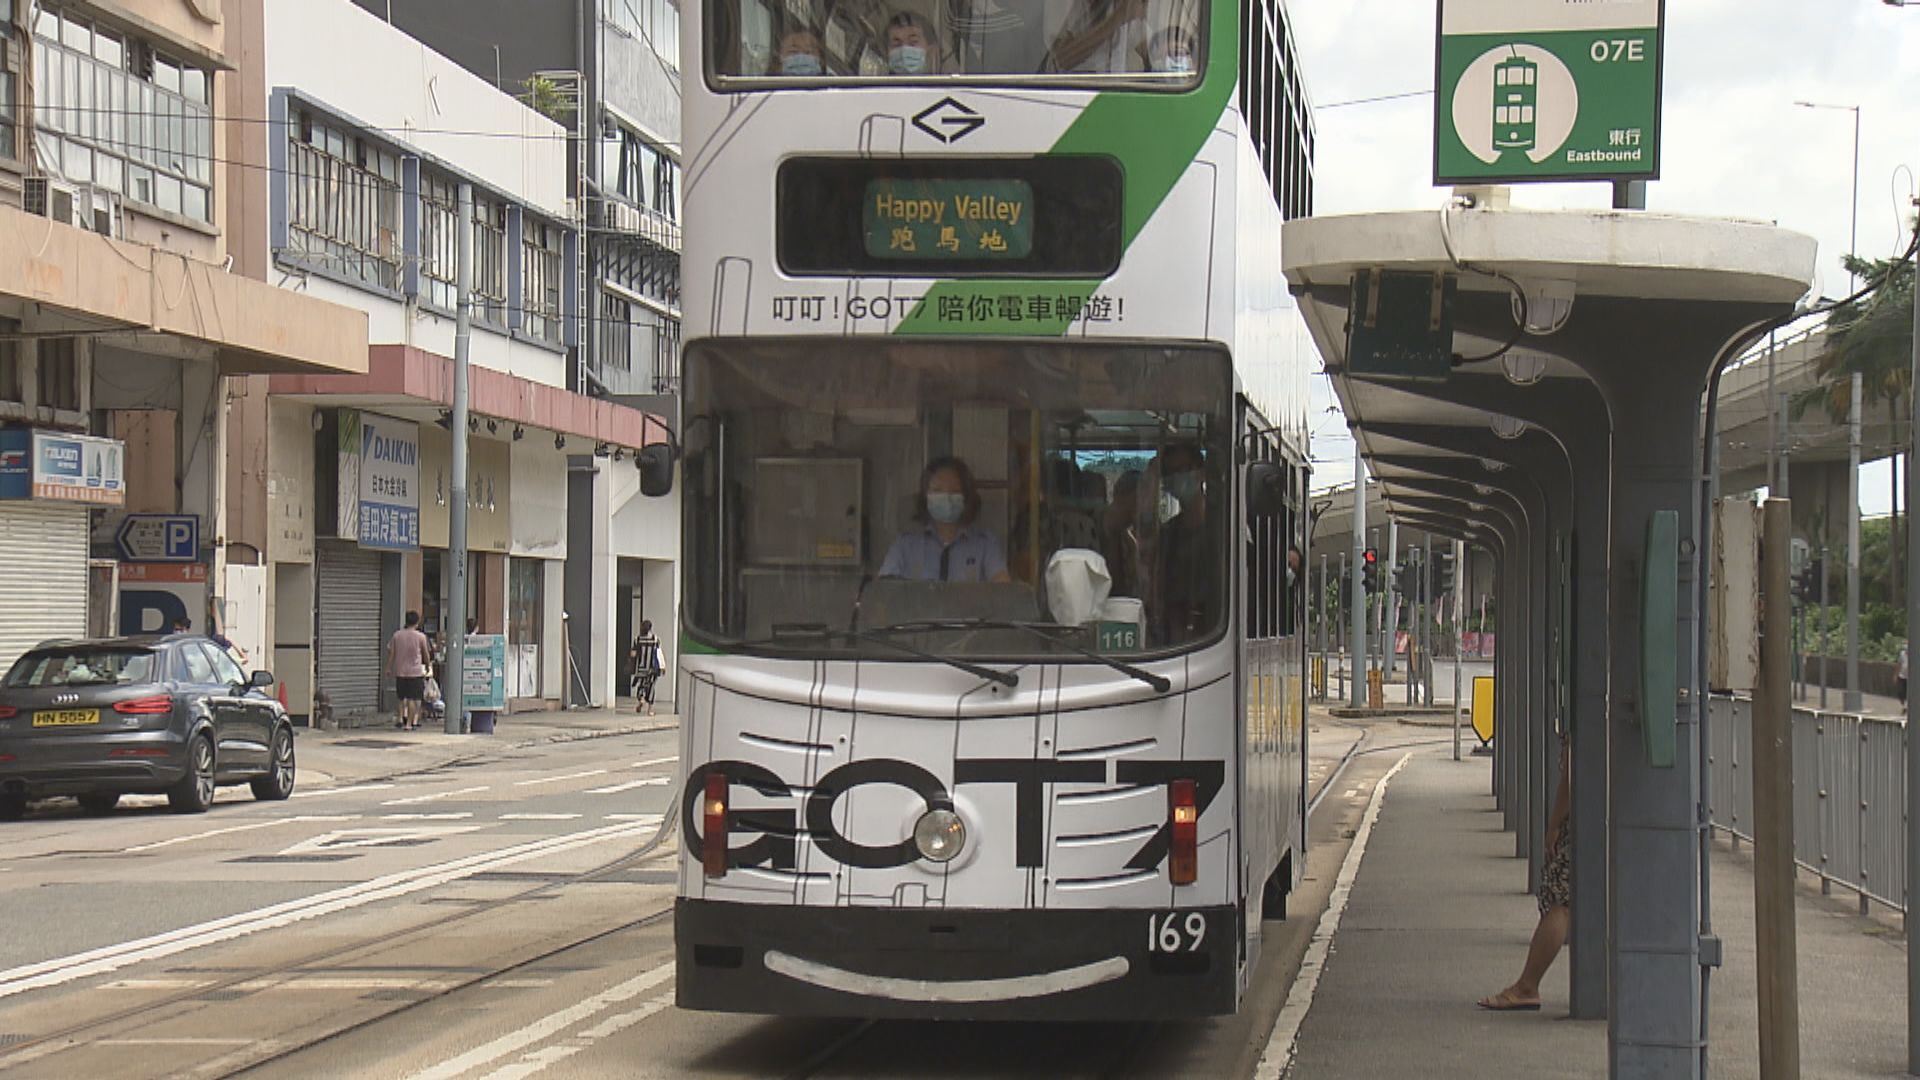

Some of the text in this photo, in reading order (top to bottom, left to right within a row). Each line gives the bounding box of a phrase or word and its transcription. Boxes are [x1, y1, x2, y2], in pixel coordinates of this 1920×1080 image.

[1590, 40, 1644, 62] 07E
[1608, 128, 1641, 146] 東行
[1566, 148, 1641, 163] Eastbound
[876, 193, 1022, 225] Happy Valley
[890, 226, 1008, 251] 跑馬地
[373, 436, 417, 466] DAIKIN
[170, 523, 192, 554] P
[1102, 631, 1135, 648] 116
[36, 713, 56, 724] HN
[683, 758, 1225, 869] GOT7
[1149, 912, 1206, 953] 169
